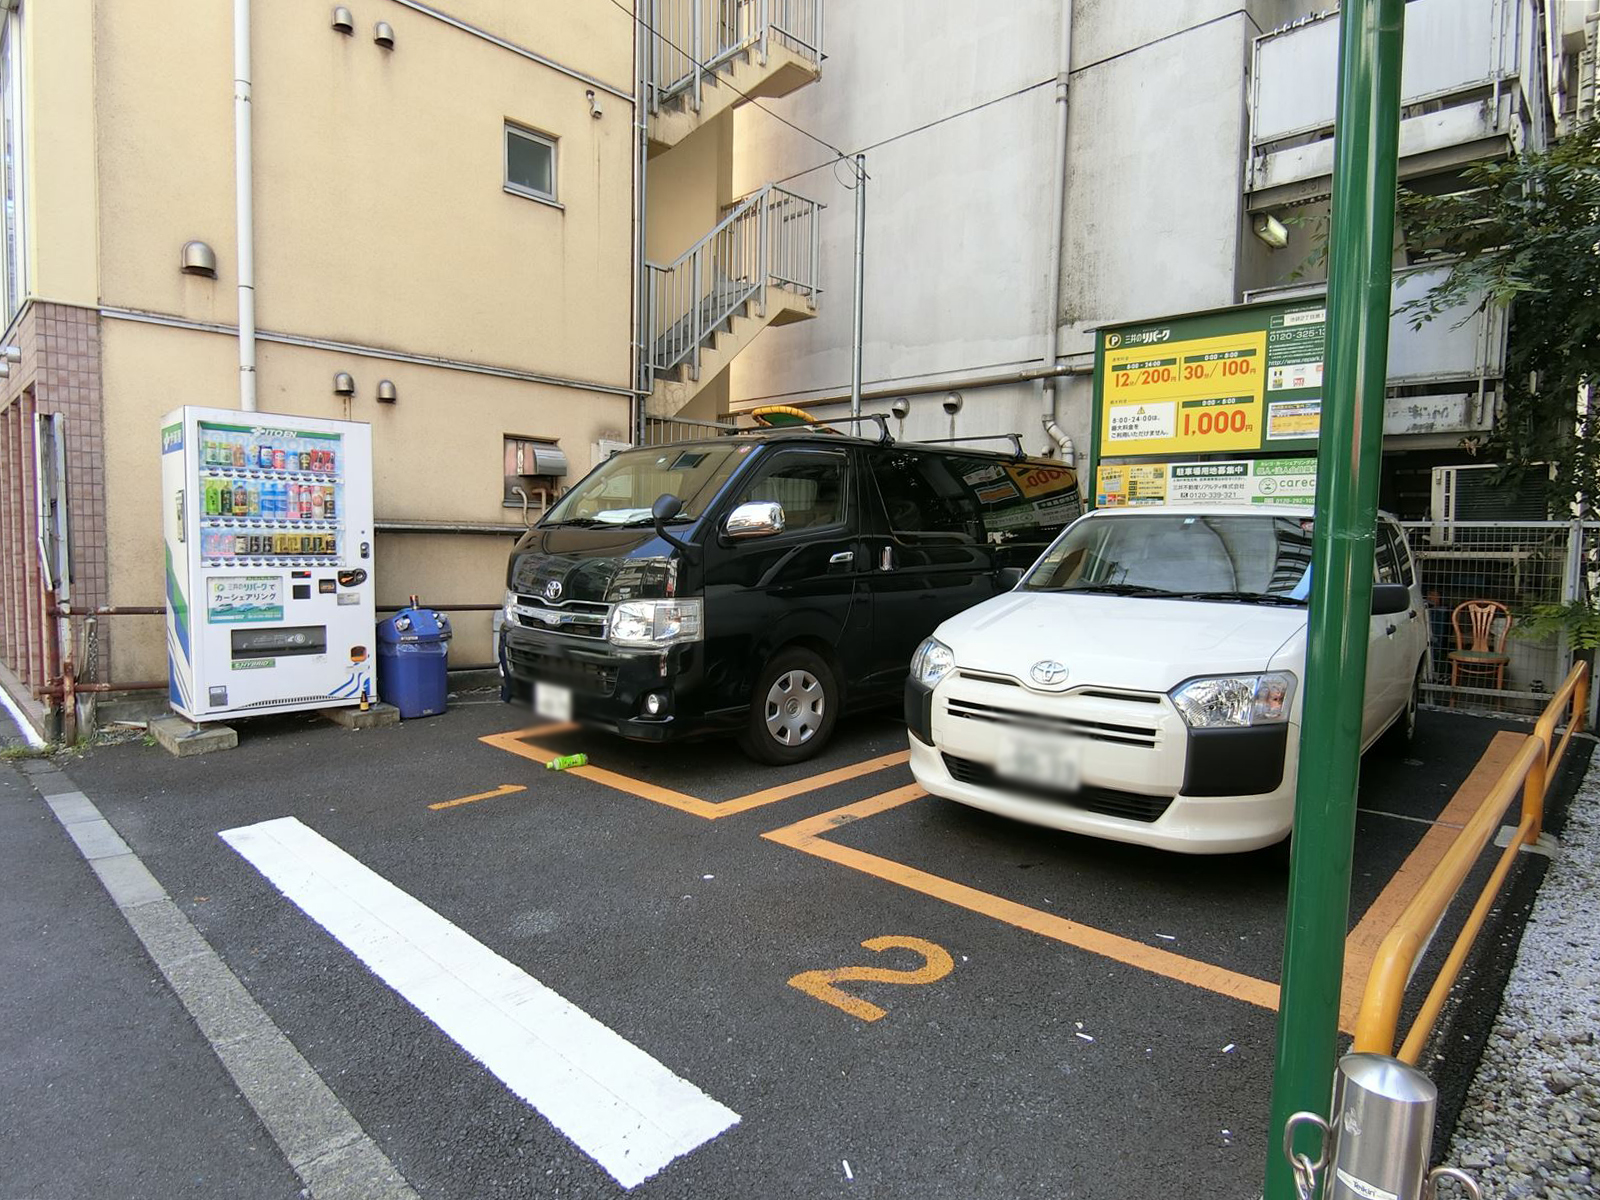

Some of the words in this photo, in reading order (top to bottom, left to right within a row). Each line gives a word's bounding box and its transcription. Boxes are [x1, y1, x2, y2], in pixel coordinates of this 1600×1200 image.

[1125, 329, 1171, 344] 三井のリパーク
[265, 429, 283, 437] ITO
[284, 430, 297, 438] EN
[1176, 466, 1243, 476] 駐車場用地募集中
[215, 593, 276, 602] カーシェアリング
[787, 935, 955, 1022] 2
